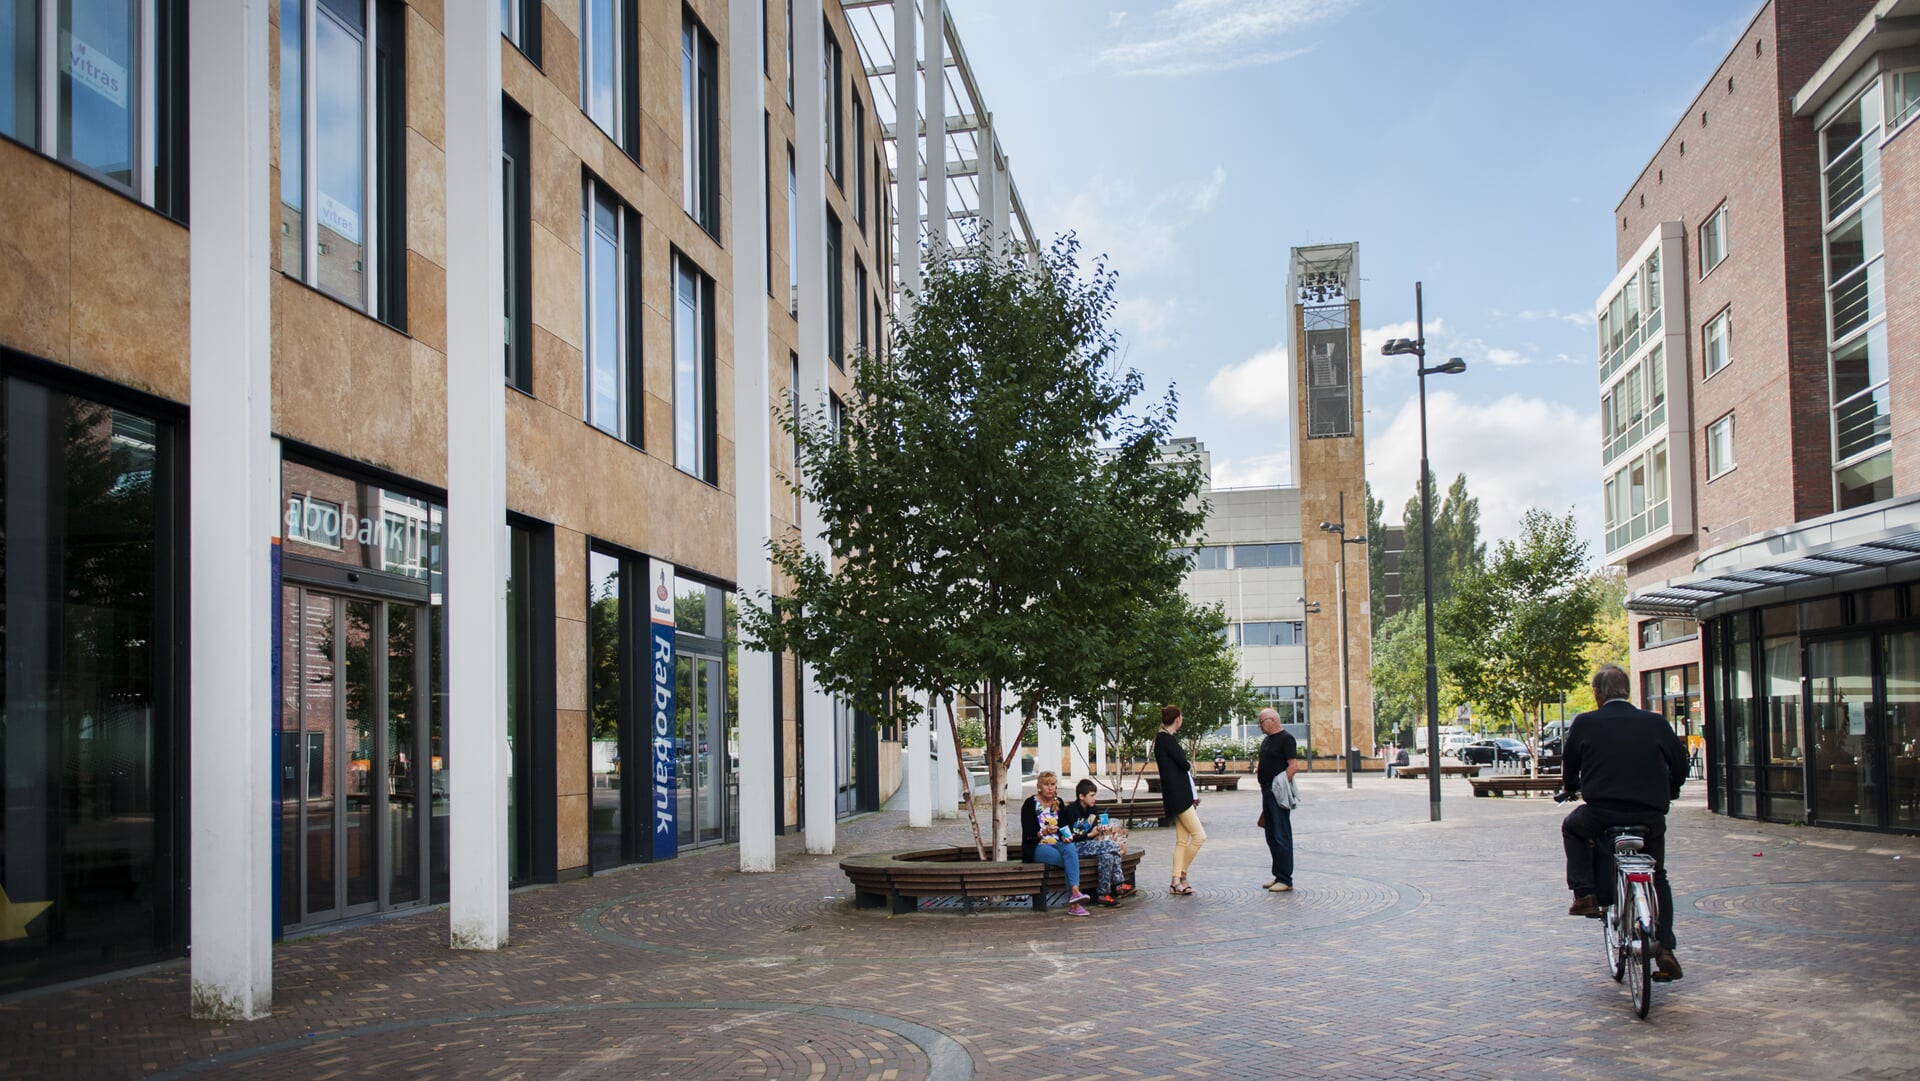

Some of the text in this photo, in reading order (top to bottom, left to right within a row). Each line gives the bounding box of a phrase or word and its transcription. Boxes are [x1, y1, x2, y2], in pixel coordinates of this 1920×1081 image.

[70, 51, 119, 92] vitras
[323, 207, 353, 232] vitras
[284, 490, 403, 551] abobank
[656, 635, 672, 834] Rabobank
